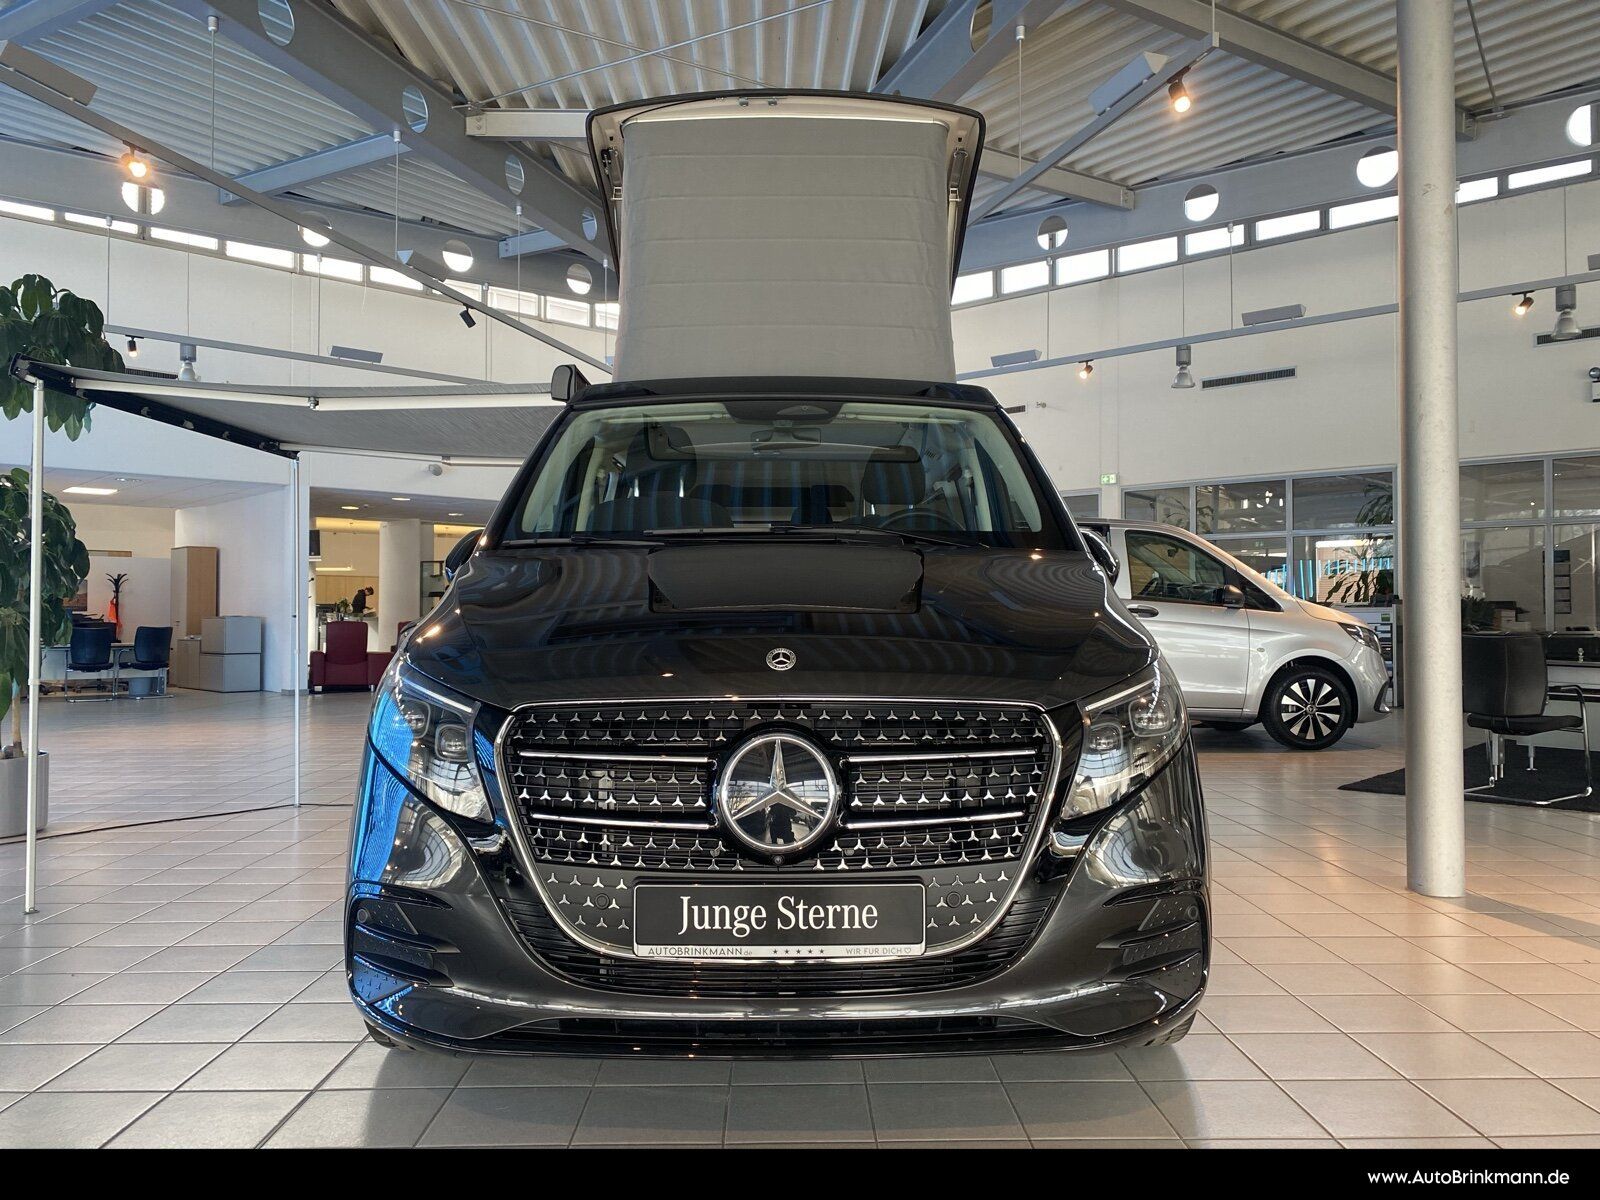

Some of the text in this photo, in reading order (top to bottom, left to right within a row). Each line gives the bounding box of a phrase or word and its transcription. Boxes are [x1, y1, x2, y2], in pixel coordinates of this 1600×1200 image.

[678, 896, 878, 938] Junge Sterne
[845, 947, 861, 955] WIR
[883, 947, 902, 955] DICH
